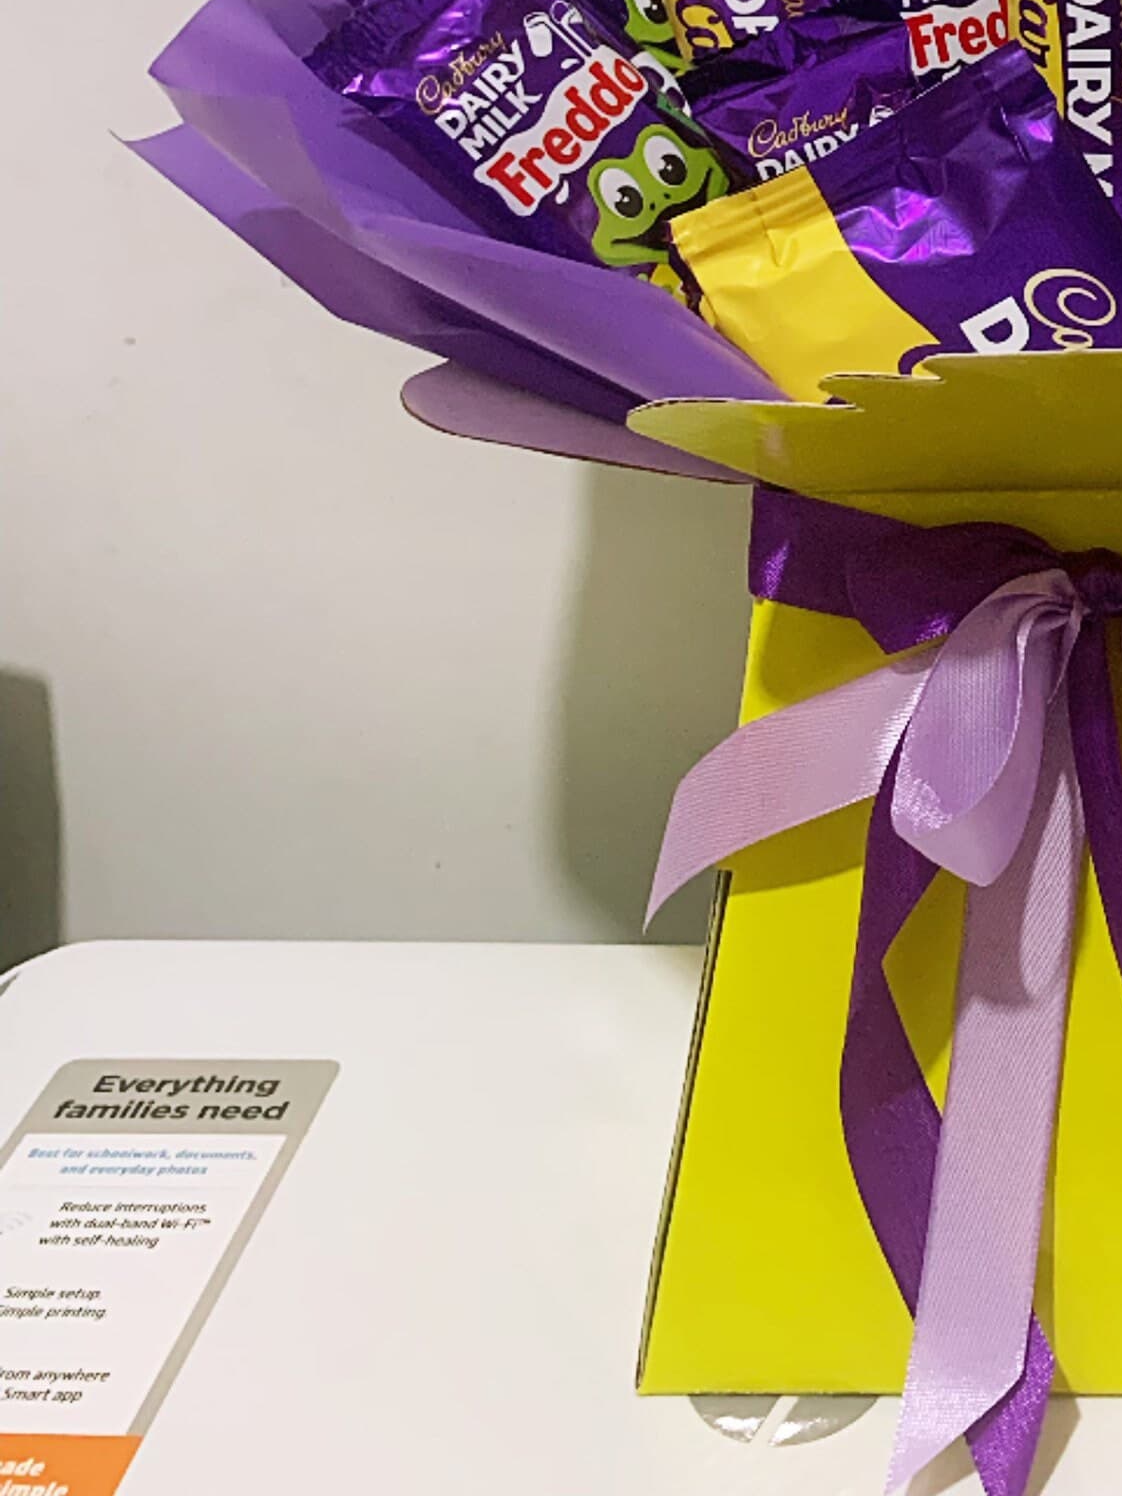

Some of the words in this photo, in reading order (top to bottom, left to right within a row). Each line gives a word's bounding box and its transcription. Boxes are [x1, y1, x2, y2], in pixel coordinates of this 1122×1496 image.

[416, 30, 505, 116] Cadbury
[434, 39, 527, 140] DAIRY
[457, 78, 543, 162] MILK
[486, 55, 646, 208] Freddo
[748, 107, 848, 158] Cadbury
[93, 1075, 281, 1097] Everything
[53, 1100, 190, 1120] families
[197, 1101, 291, 1121] need
[28, 1148, 60, 1159] Best
[62, 1148, 84, 1159] for
[59, 1164, 86, 1175] and
[88, 1164, 154, 1176] everyday
[156, 1164, 208, 1176] photos
[59, 1201, 112, 1213] Reduce
[114, 1201, 207, 1215] interruptions
[49, 1218, 81, 1229] with
[38, 1235, 70, 1246] with
[74, 1235, 160, 1249] self-healing
[5, 1287, 55, 1301] Simple
[57, 1288, 101, 1301] setup
[44, 1306, 107, 1321] printing
[0, 1366, 31, 1381] rom
[32, 1368, 111, 1384] anywhere
[2, 1387, 50, 1401] Smart
[52, 1390, 83, 1403] app
[0, 1458, 46, 1477] ade
[0, 1479, 69, 1496] imple
